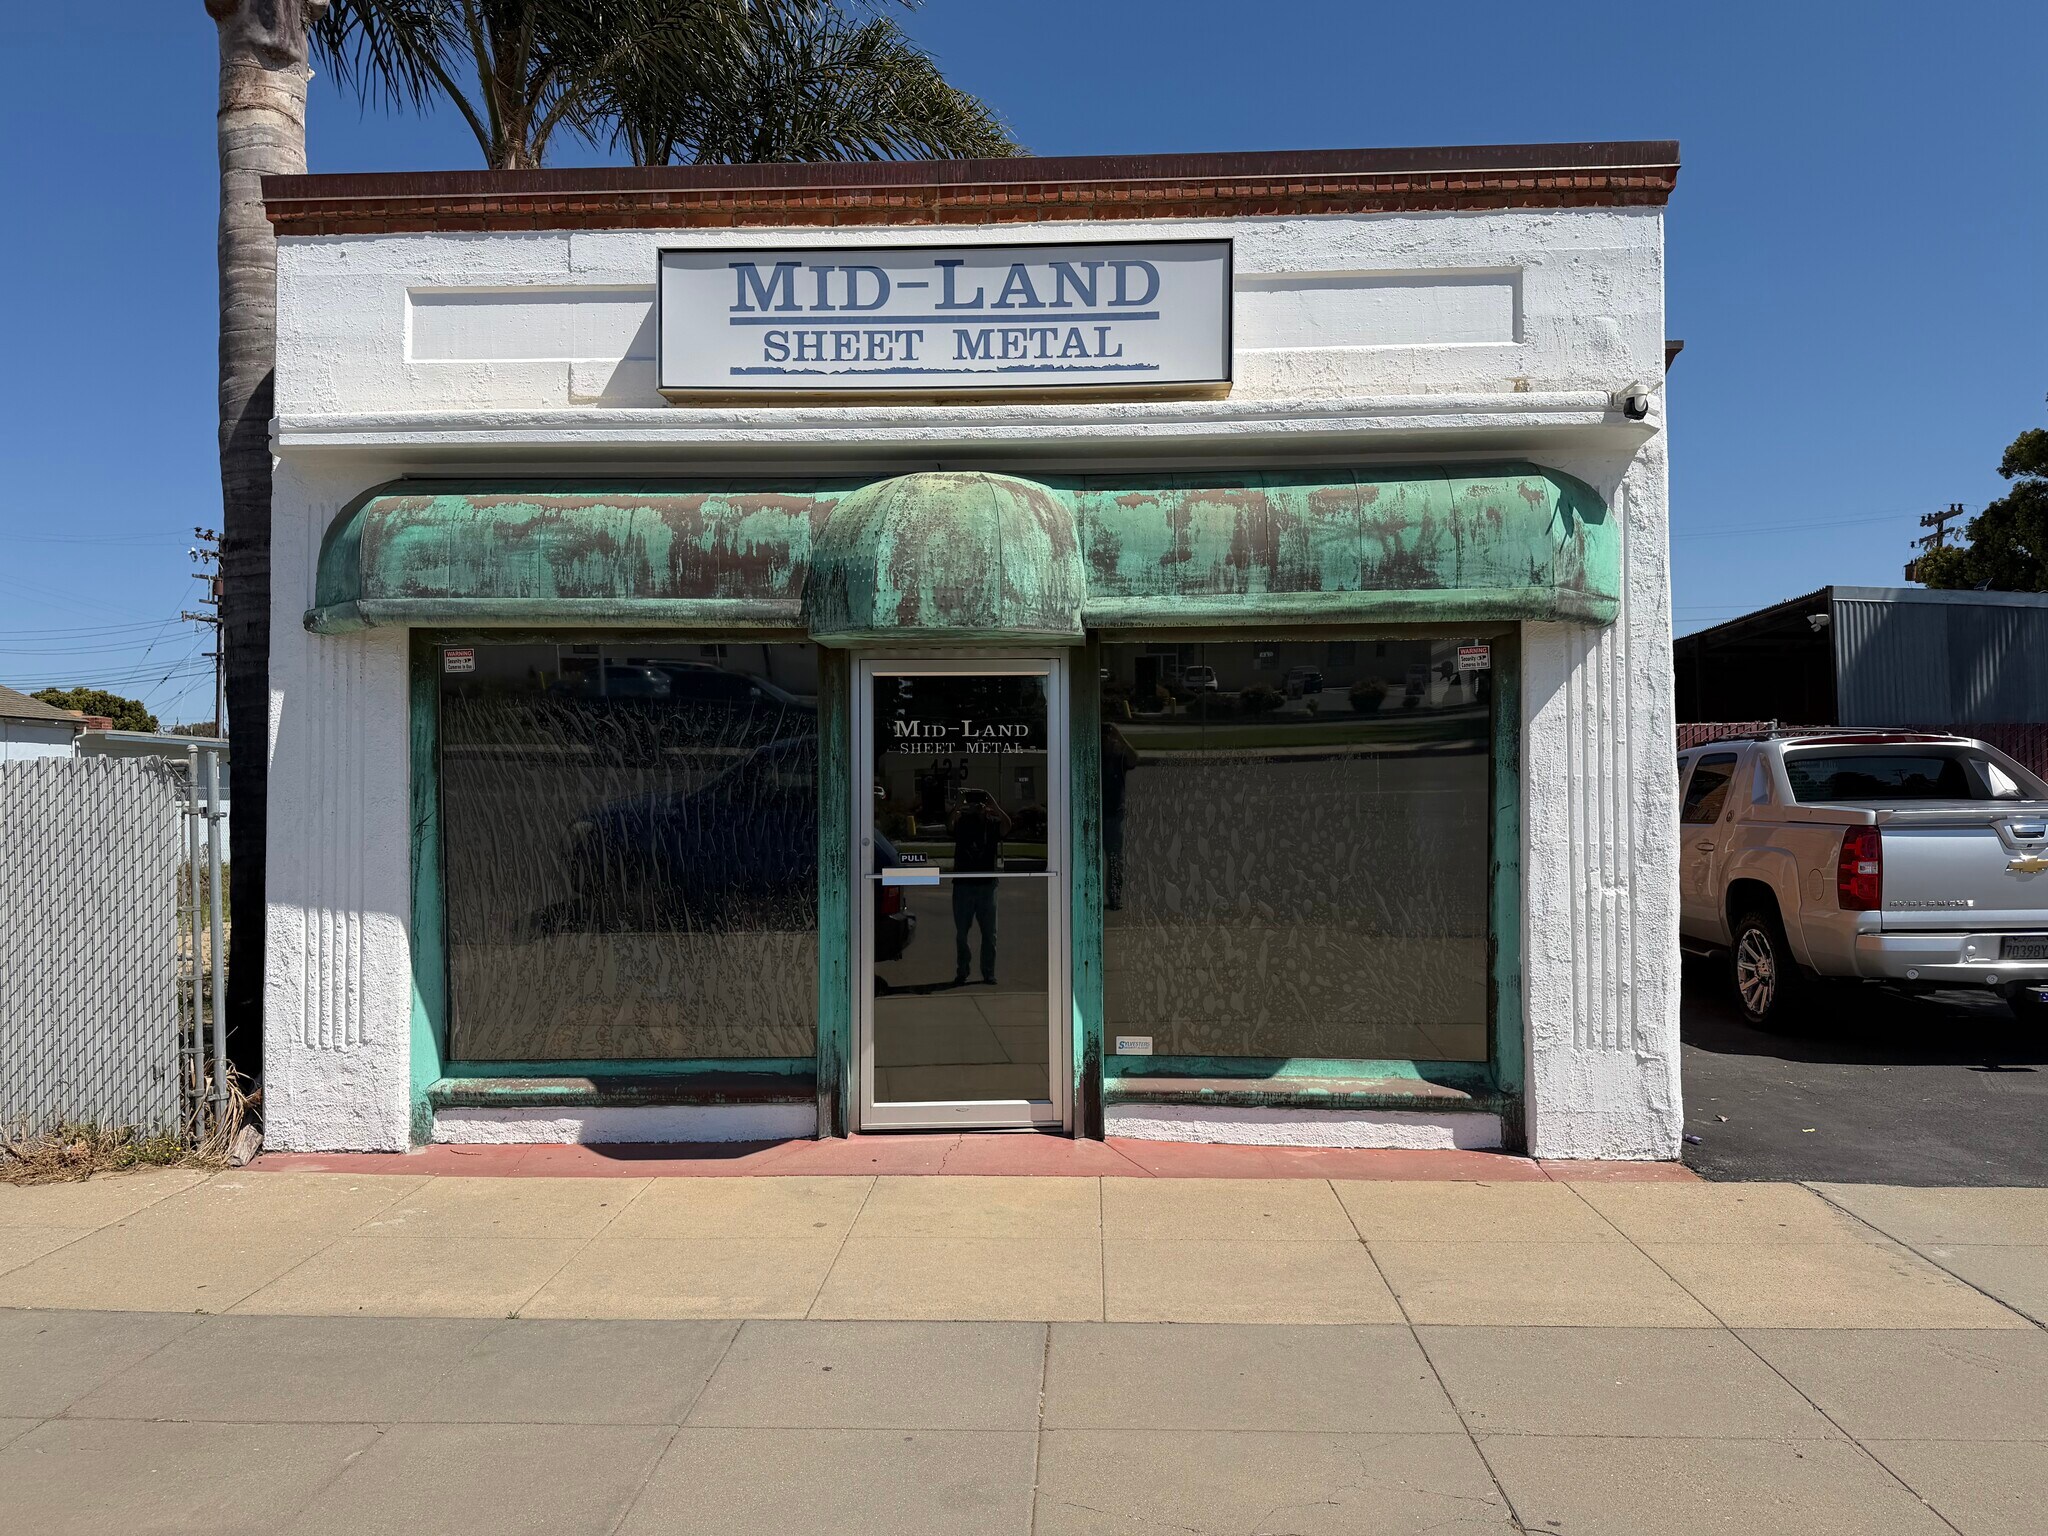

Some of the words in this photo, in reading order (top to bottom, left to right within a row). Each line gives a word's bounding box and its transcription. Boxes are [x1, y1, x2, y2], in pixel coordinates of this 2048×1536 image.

[728, 259, 1161, 312] MID-LAND
[763, 329, 924, 362] SHEET
[952, 326, 1124, 360] METAL
[894, 719, 1029, 738] MID-LAND
[900, 742, 956, 754] SHEET
[966, 741, 1024, 754] METAL
[930, 758, 969, 780] 125
[901, 854, 926, 862] PULL
